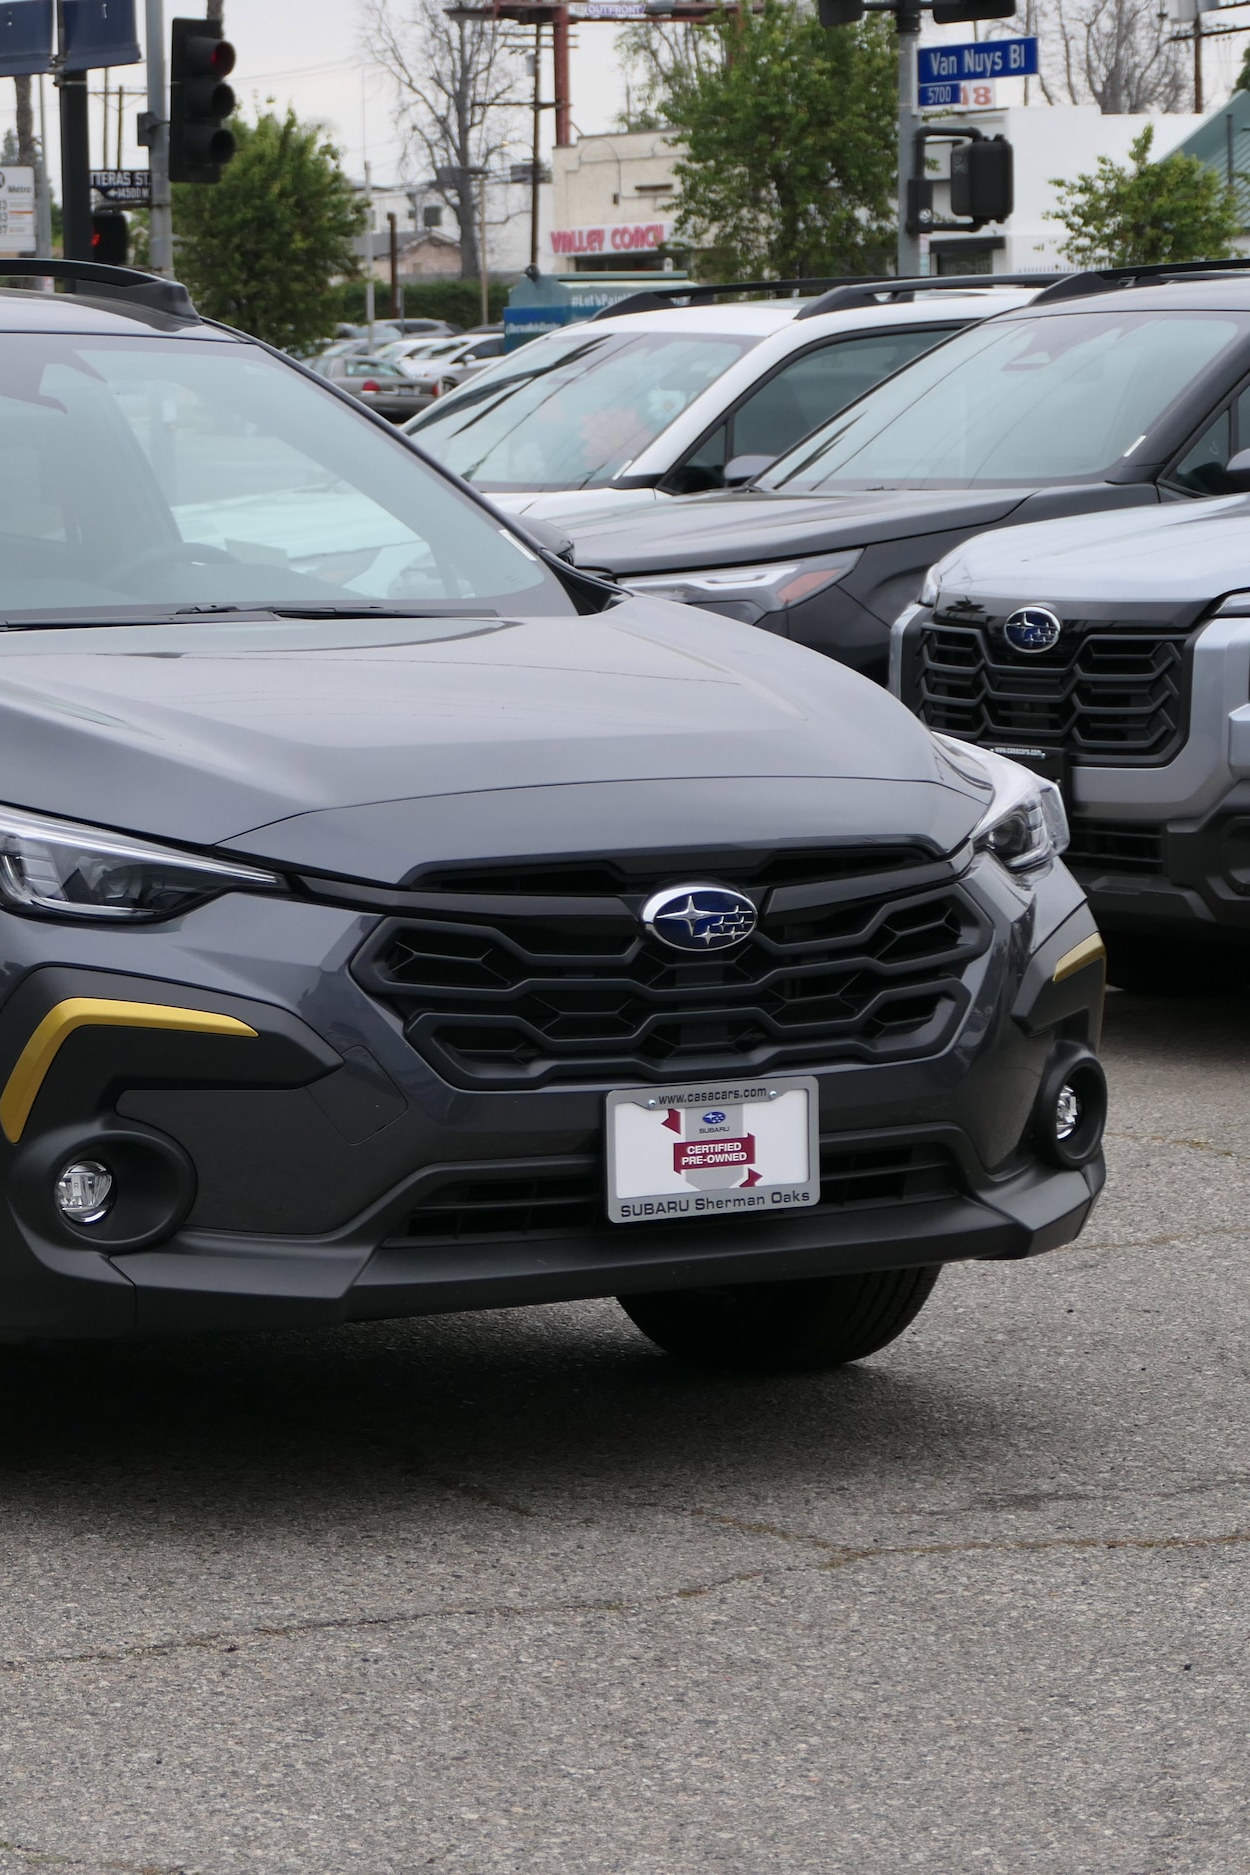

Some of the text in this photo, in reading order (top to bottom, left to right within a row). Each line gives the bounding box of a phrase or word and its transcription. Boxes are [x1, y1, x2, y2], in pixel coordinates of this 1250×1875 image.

[588, 4, 641, 14] OUTFRONT
[930, 43, 1025, 77] Van Nuys Bl
[928, 85, 952, 104] 5700
[8, 185, 31, 193] Metro
[550, 223, 665, 254] VALLEY COACH
[658, 1086, 767, 1105] www.casacars.com
[699, 1126, 730, 1134] SUBARU
[686, 1142, 742, 1155] CERTIFIED
[681, 1152, 748, 1166] PRE-OWNED
[621, 1190, 810, 1218] SUBARU Sherman Oaks
